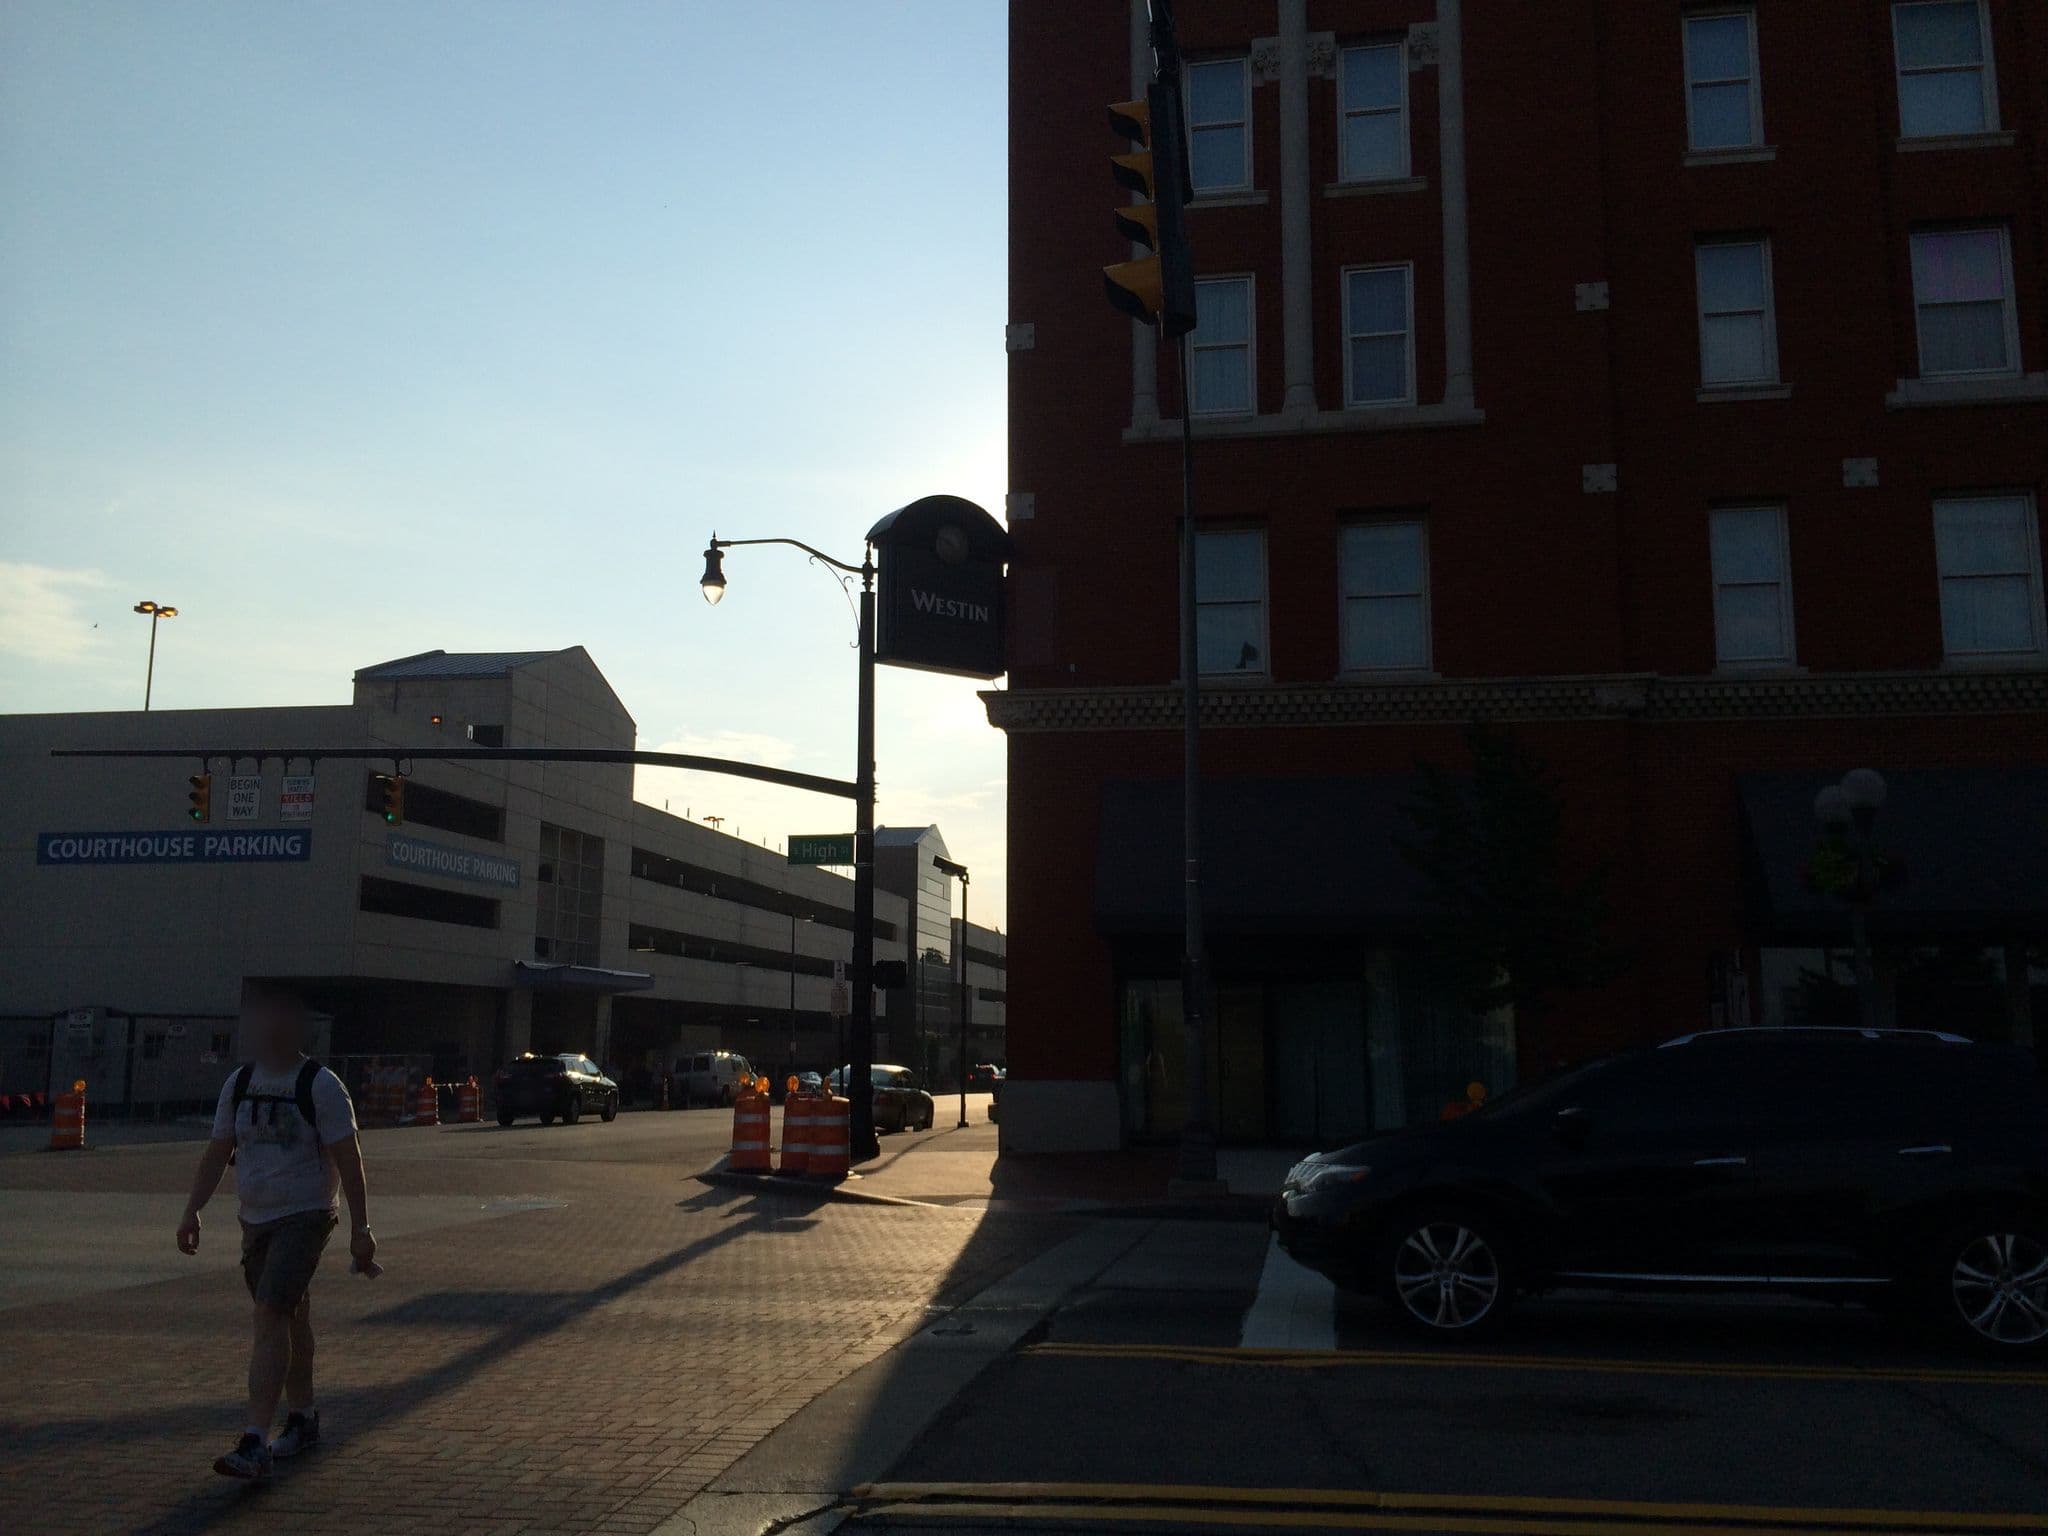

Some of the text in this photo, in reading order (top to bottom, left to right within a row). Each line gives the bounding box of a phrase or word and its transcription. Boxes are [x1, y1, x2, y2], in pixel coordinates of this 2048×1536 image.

[911, 588, 988, 621] WESTIN
[230, 779, 260, 791] BEGIN
[234, 792, 255, 804] ONE
[233, 806, 254, 817] WAY
[48, 835, 302, 859] COURTHOUSE PARKING
[802, 842, 836, 862] High
[392, 841, 516, 883] COURTHOUSE PARKING
